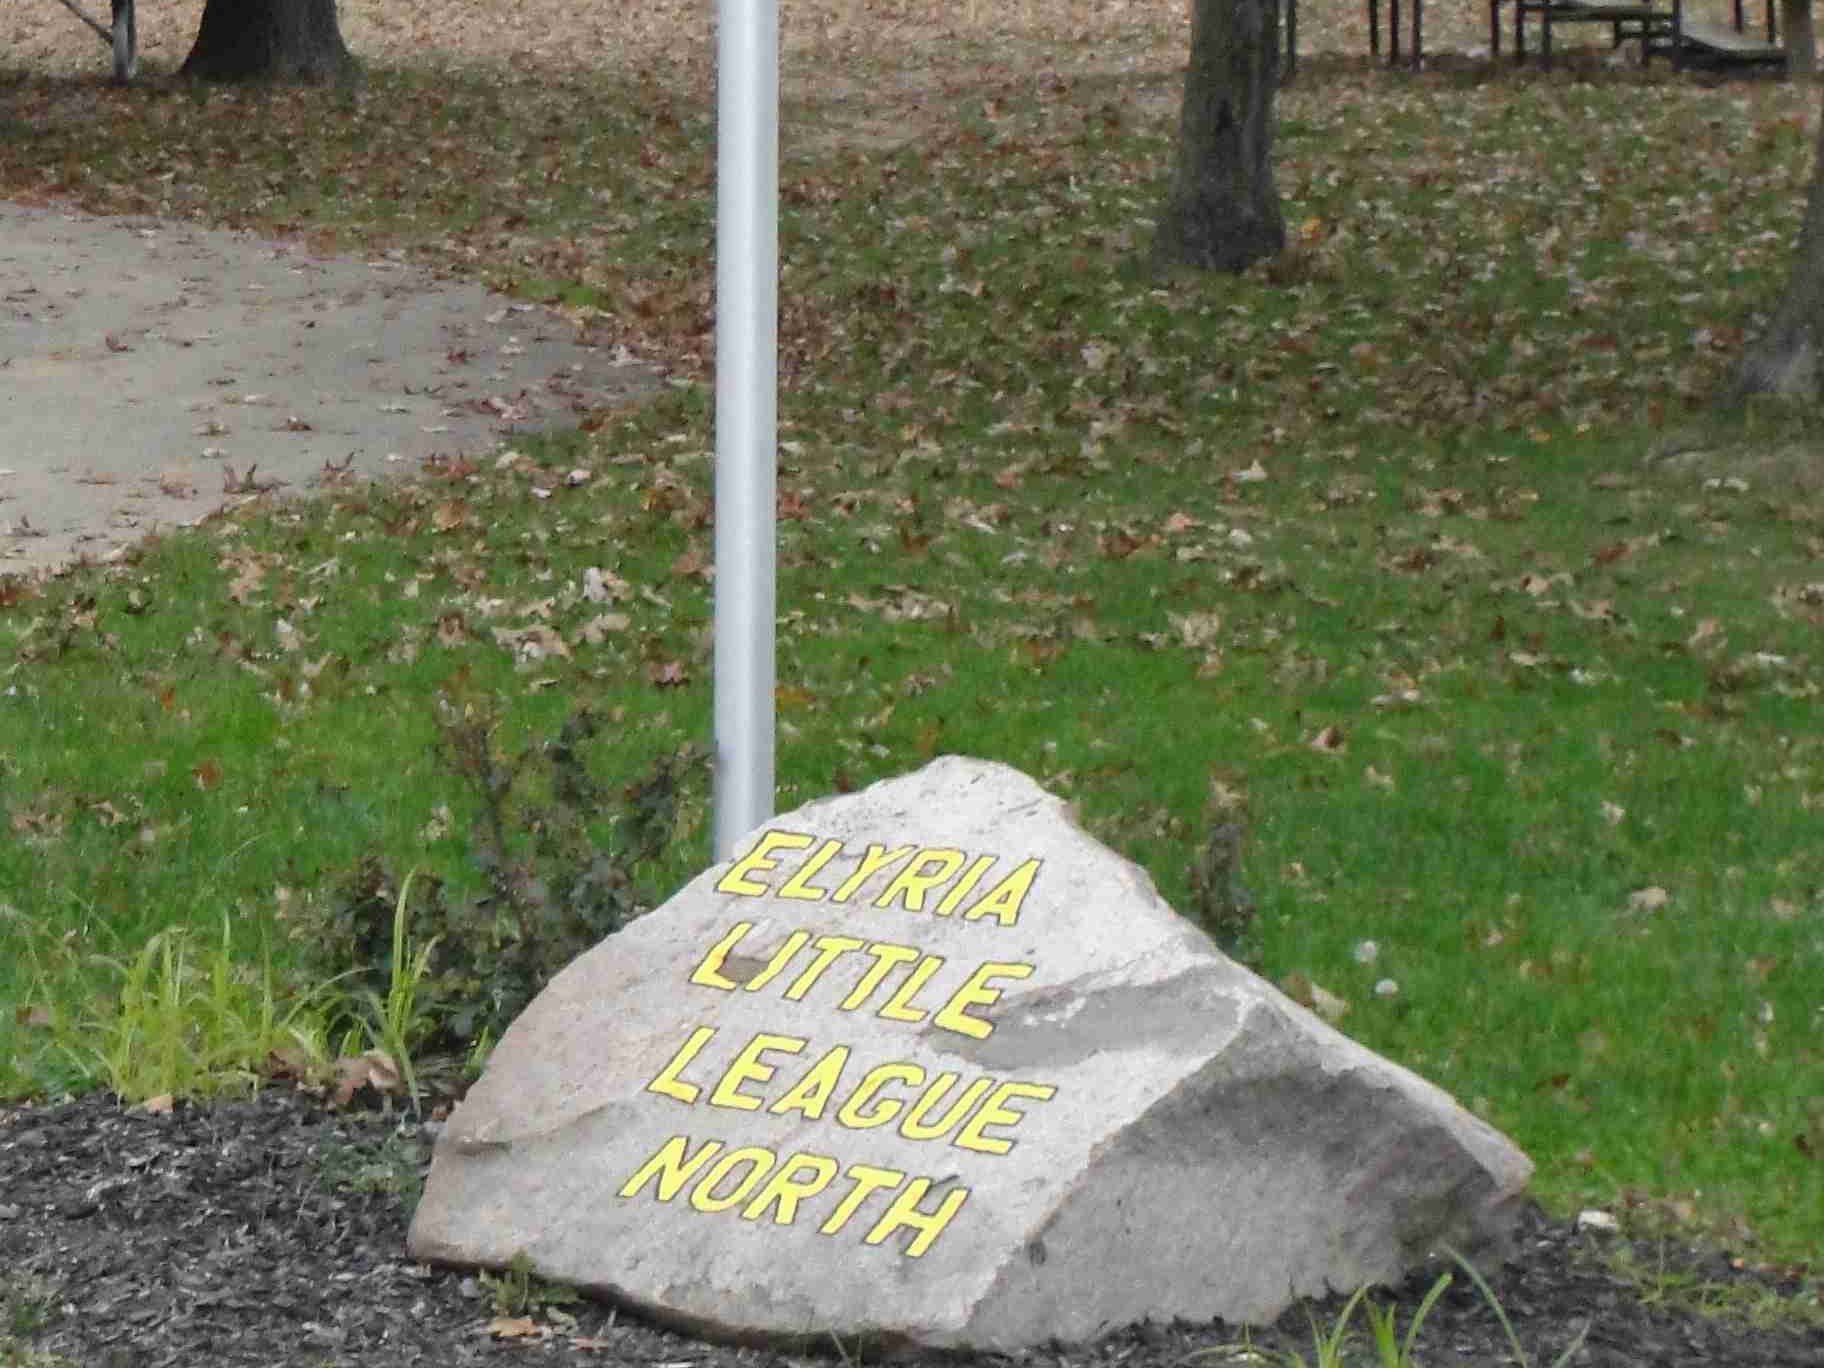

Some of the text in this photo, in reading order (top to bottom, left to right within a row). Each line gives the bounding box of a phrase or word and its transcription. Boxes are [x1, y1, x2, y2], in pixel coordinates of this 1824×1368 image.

[715, 830, 1043, 926] ELYRIA
[689, 922, 1036, 1040] LITTLE
[647, 1026, 1058, 1155] LEAGUE
[618, 1135, 972, 1258] NORTH
